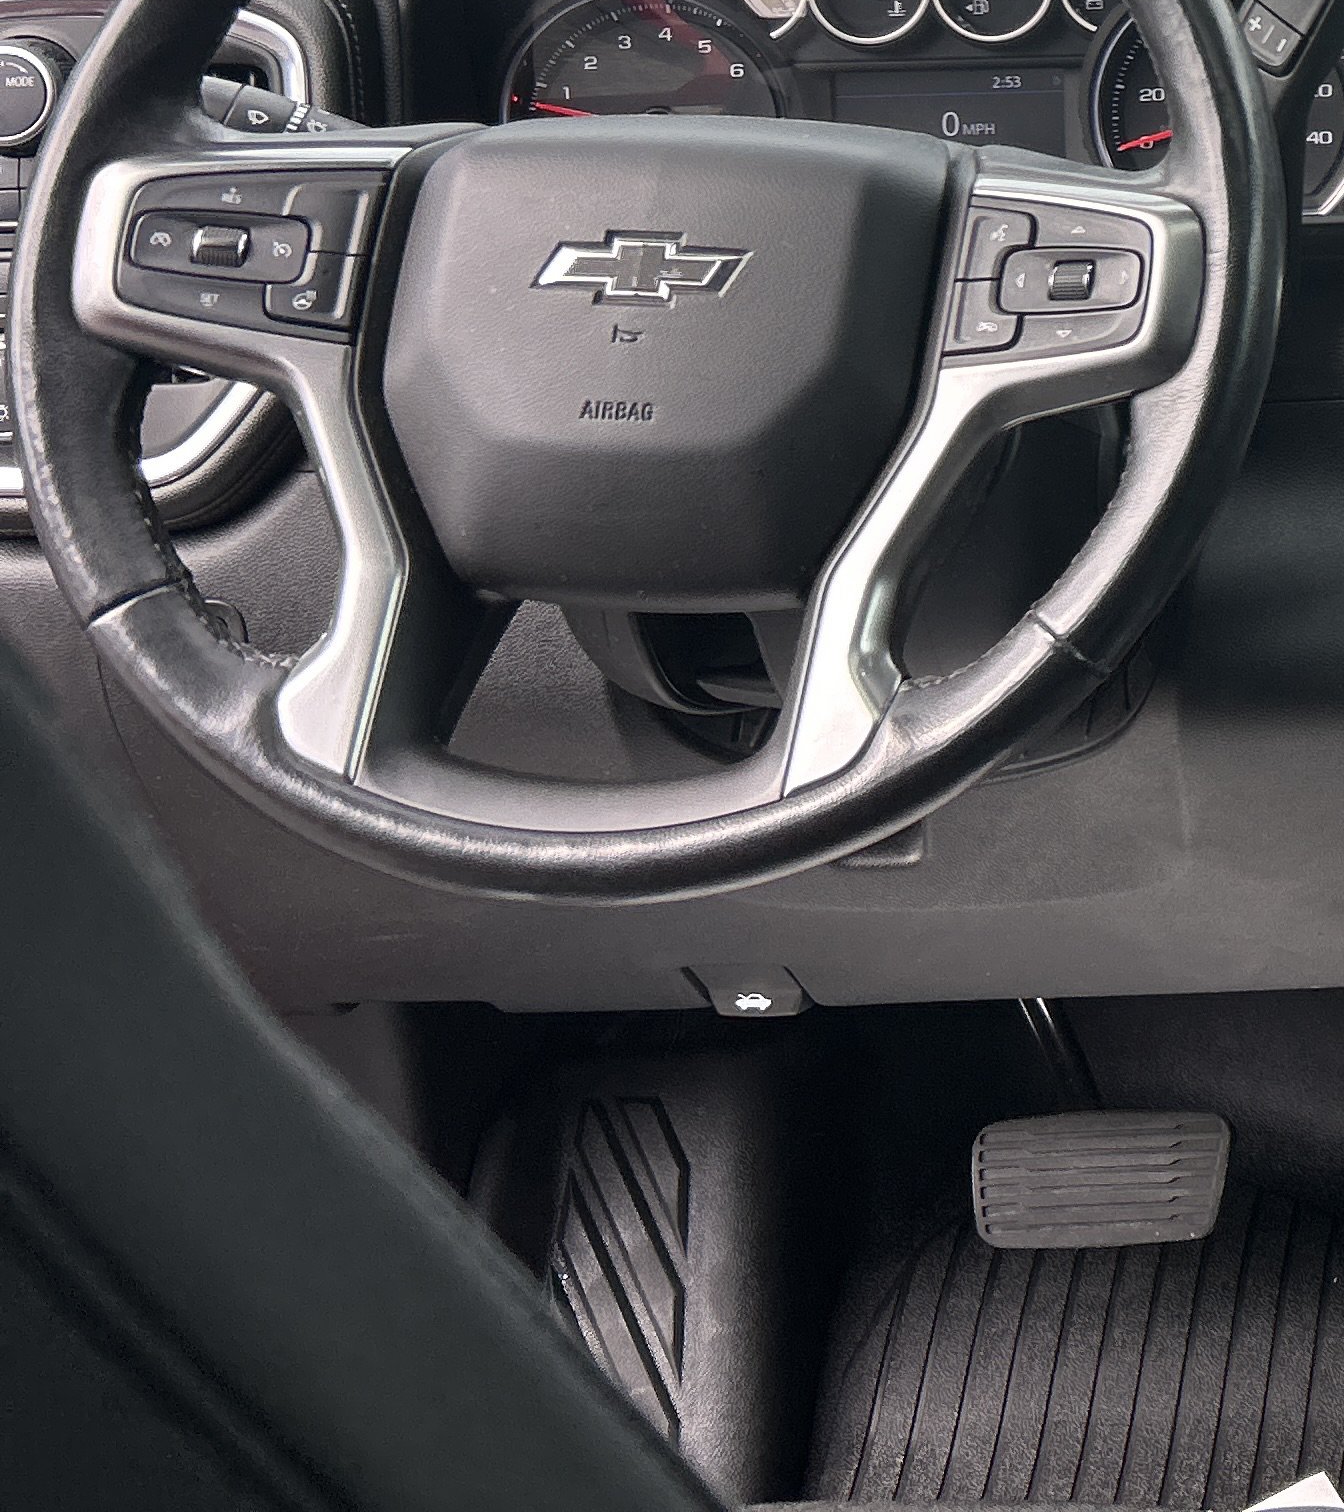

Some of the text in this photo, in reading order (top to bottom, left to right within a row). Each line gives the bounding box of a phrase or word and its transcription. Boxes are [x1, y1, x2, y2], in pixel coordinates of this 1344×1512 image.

[658, 27, 673, 42] 4
[618, 35, 632, 50] 3
[698, 39, 712, 54] 5
[584, 55, 598, 70] 2
[729, 63, 744, 78] 6
[5, 75, 36, 88] MODE
[992, 75, 1022, 89] 2:53
[562, 86, 570, 100] 1
[1139, 87, 1165, 103] 20
[942, 111, 996, 137] 0 MPH
[578, 401, 655, 424] AIRBAG
